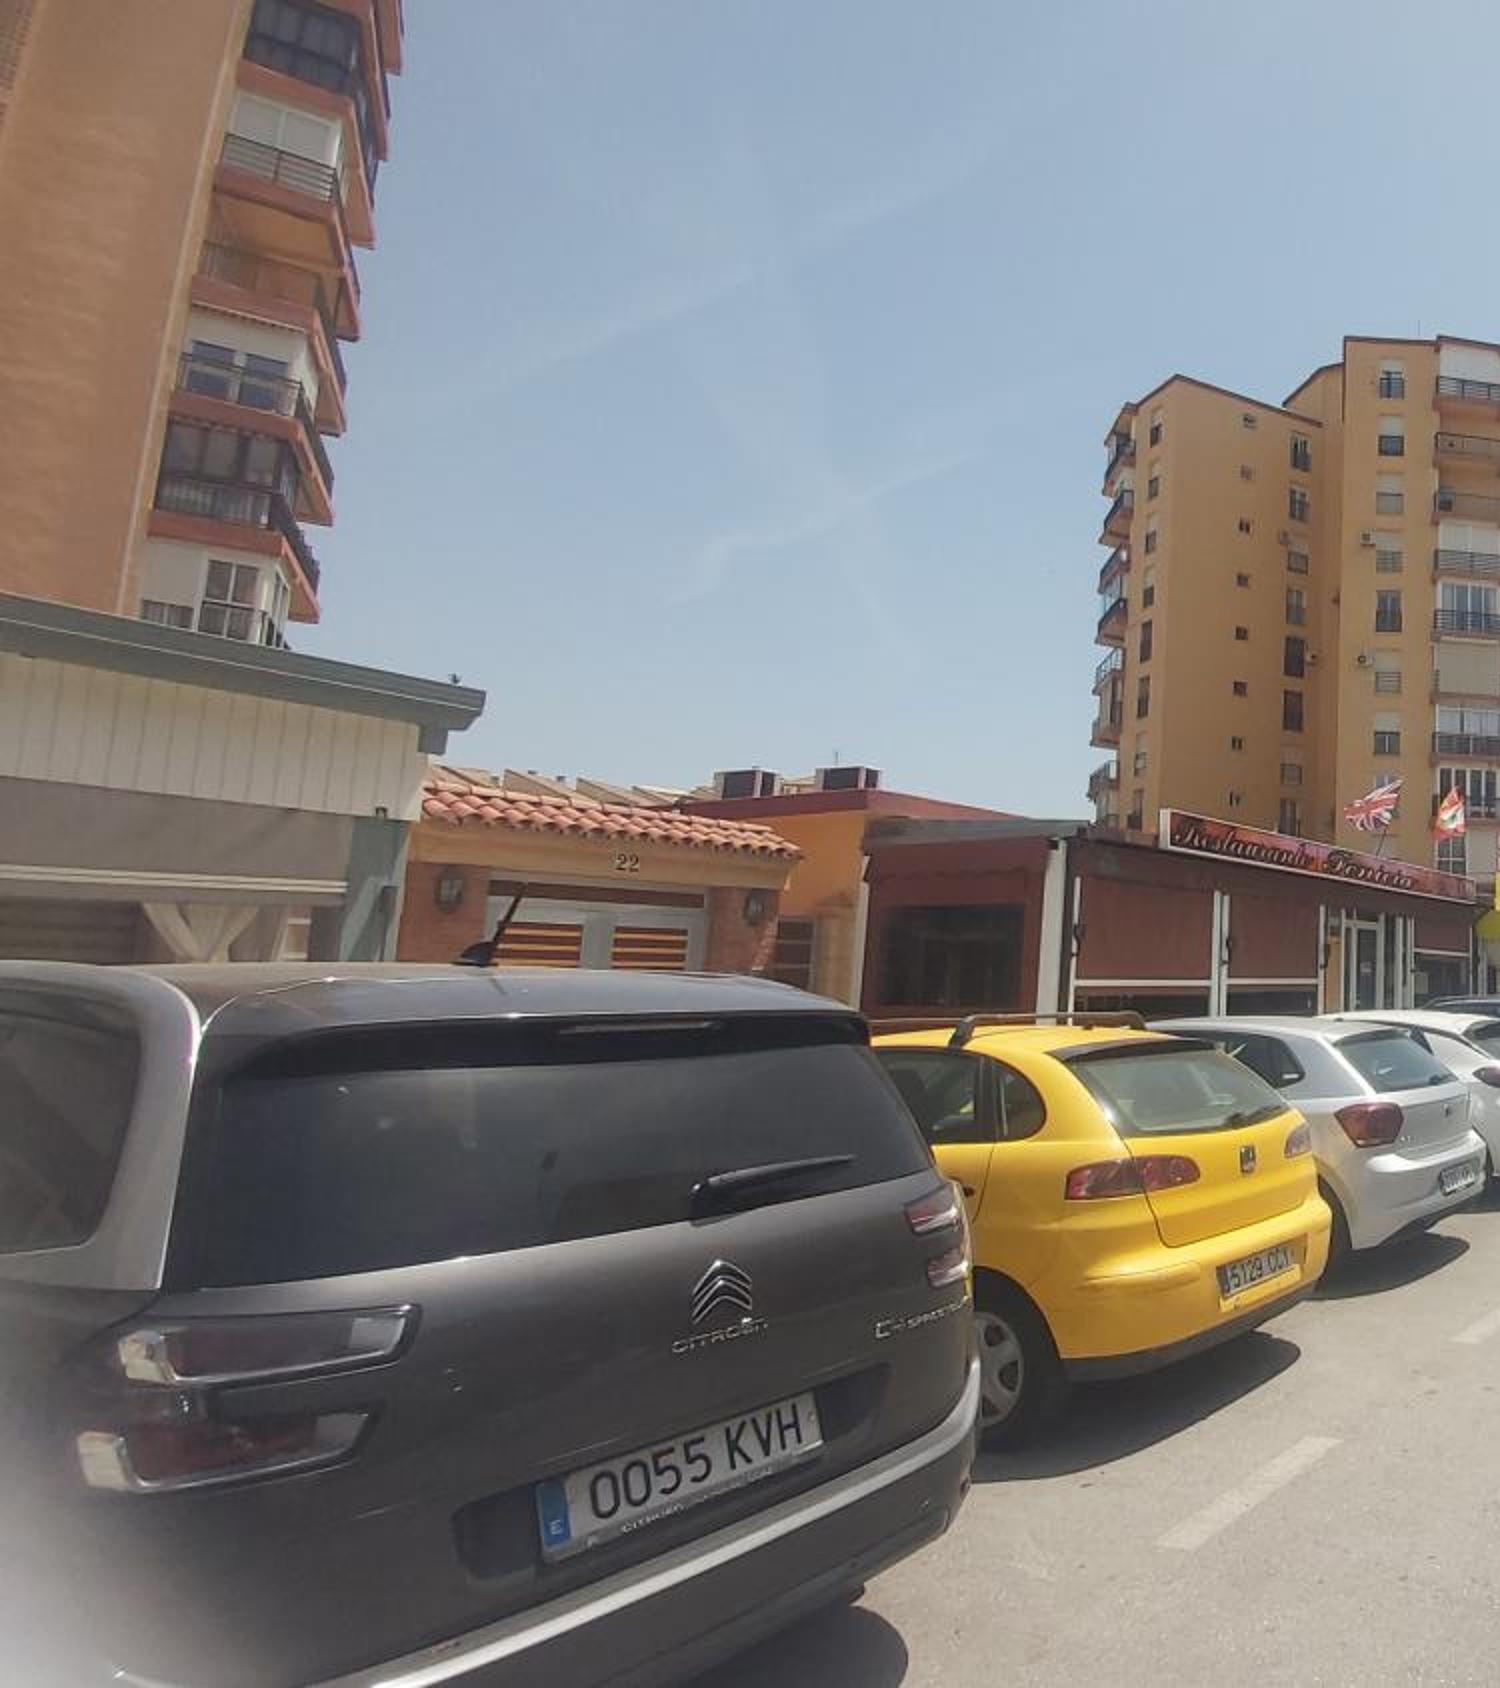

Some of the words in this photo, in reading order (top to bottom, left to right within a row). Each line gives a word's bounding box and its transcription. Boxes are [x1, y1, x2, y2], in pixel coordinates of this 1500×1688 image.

[615, 852, 639, 873] 22
[589, 1438, 713, 1520] 0055
[724, 1402, 803, 1470] KVH
